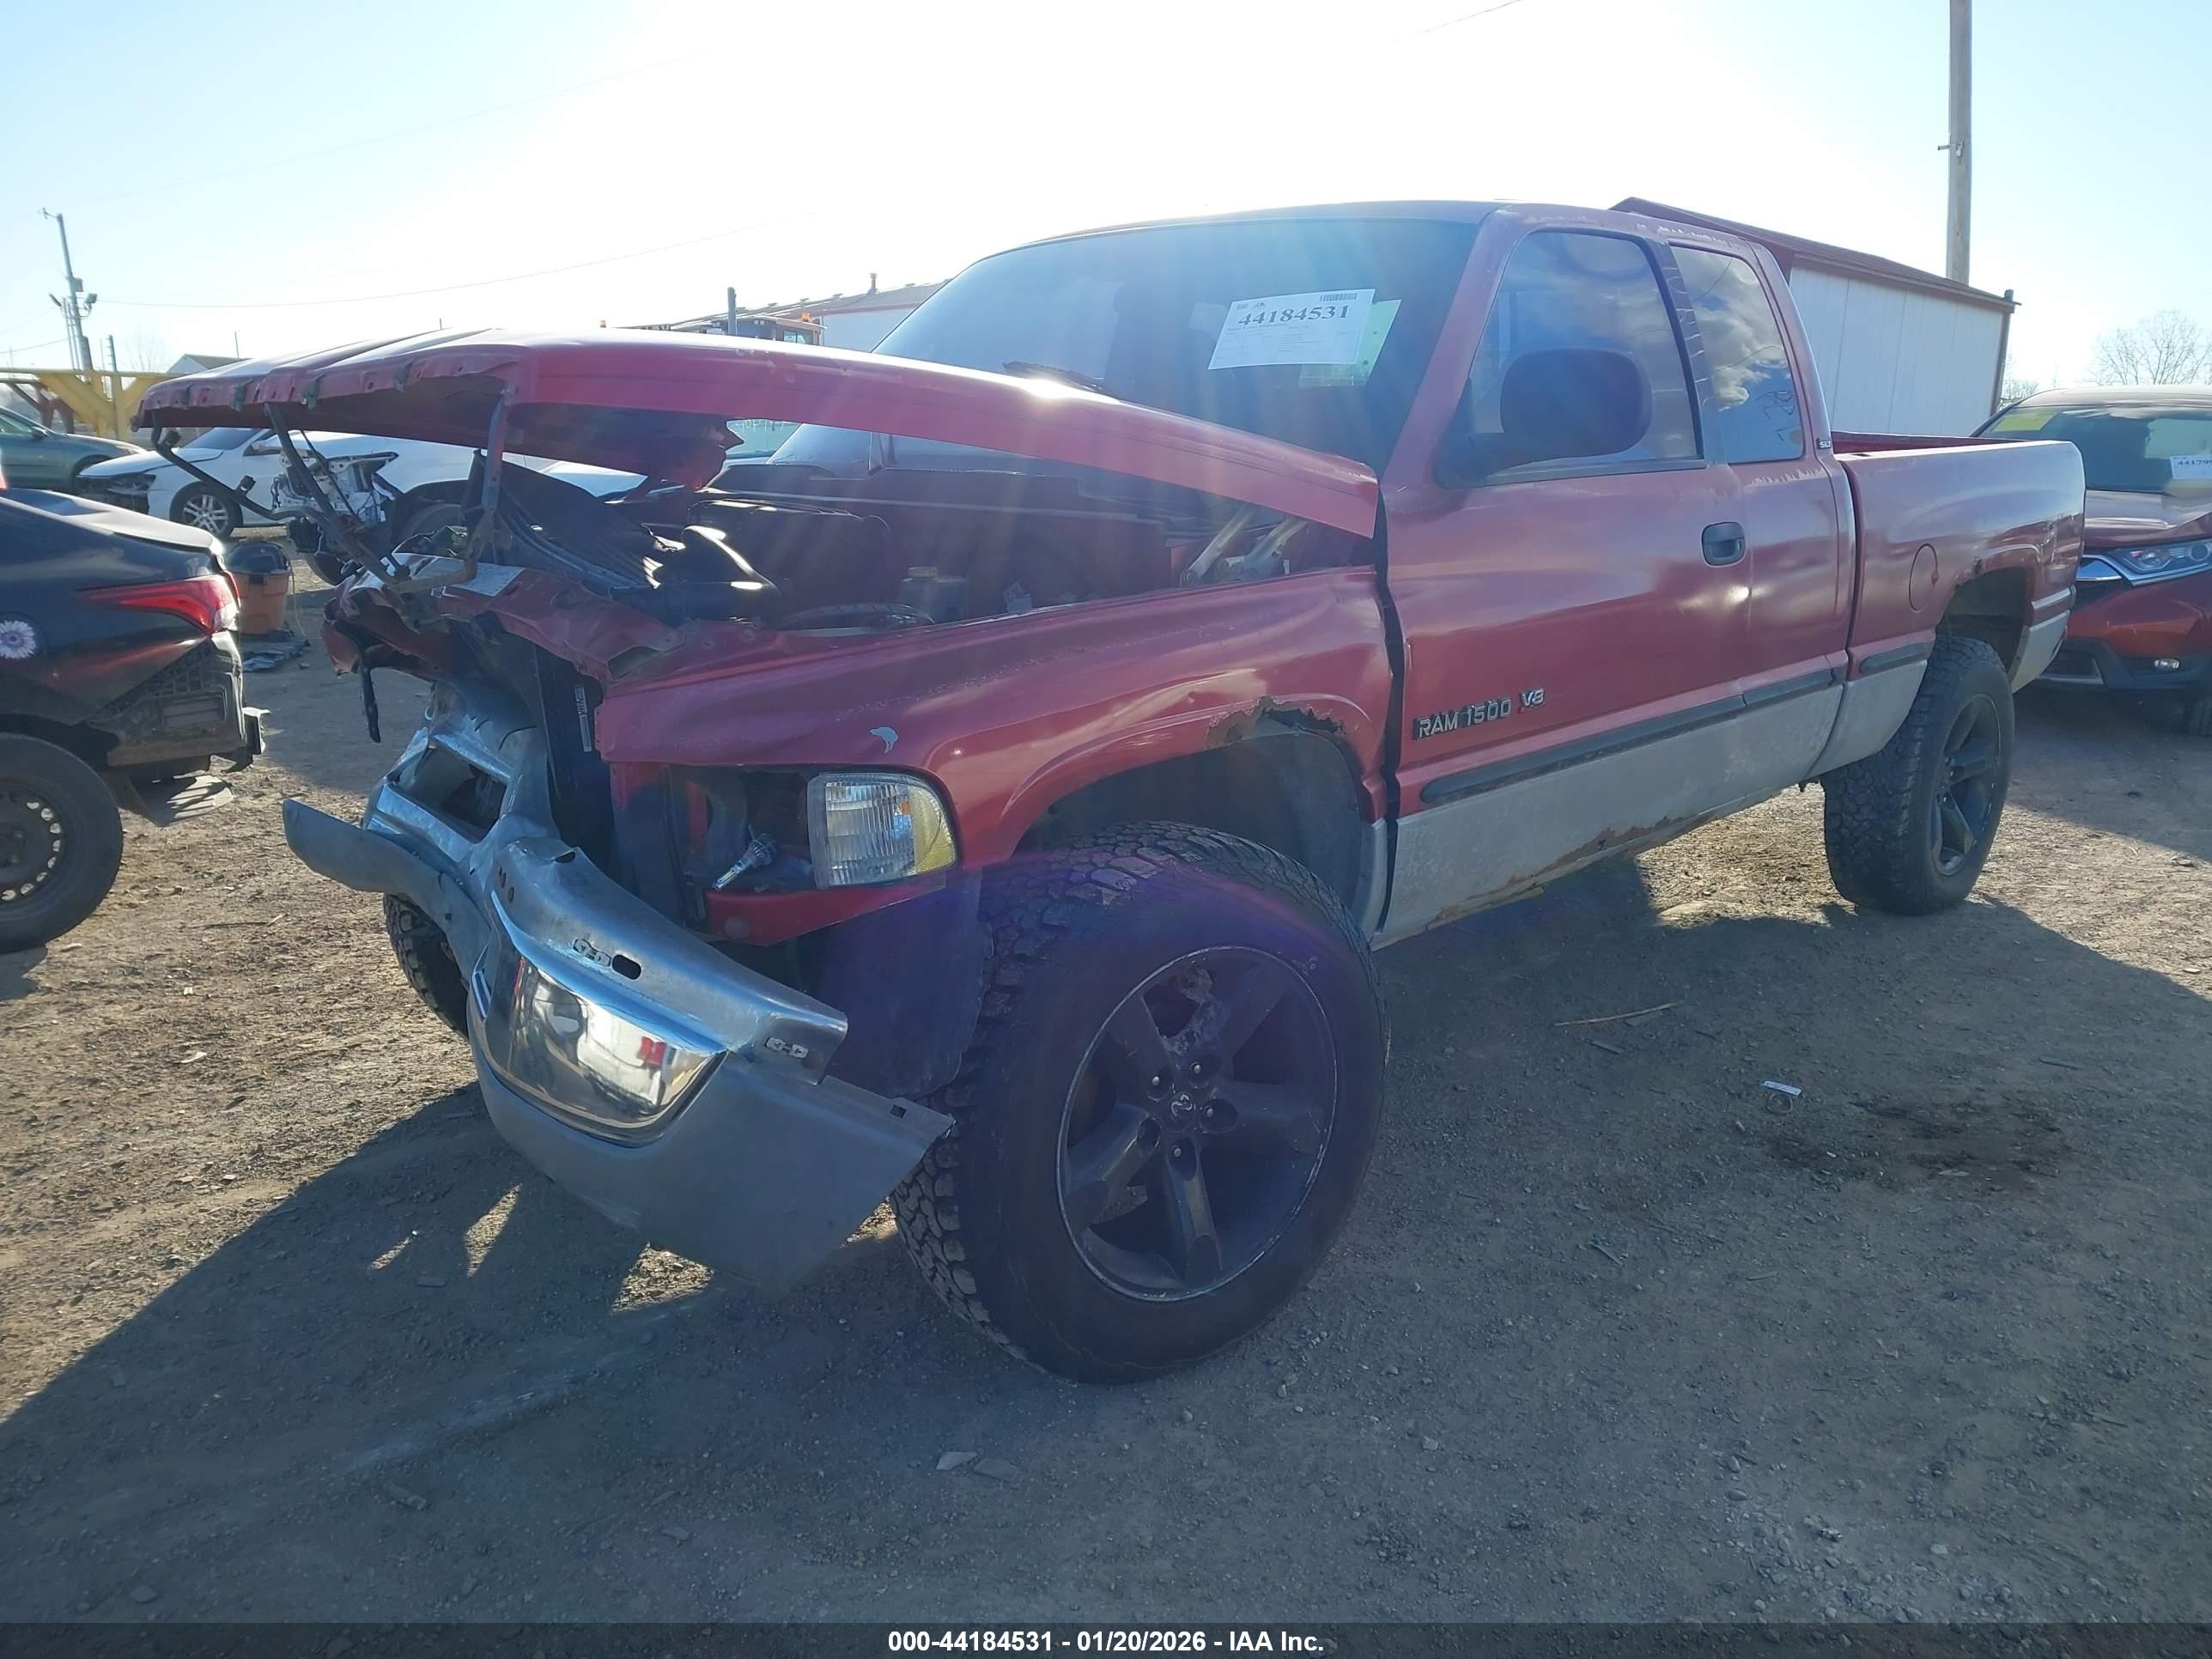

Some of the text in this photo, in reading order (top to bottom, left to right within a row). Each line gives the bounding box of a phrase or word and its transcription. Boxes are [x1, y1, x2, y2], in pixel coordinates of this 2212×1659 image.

[1237, 305, 1350, 325] 44184531
[1819, 440, 1832, 449] SLT
[1418, 688, 1546, 739] RAM 1500 V8
